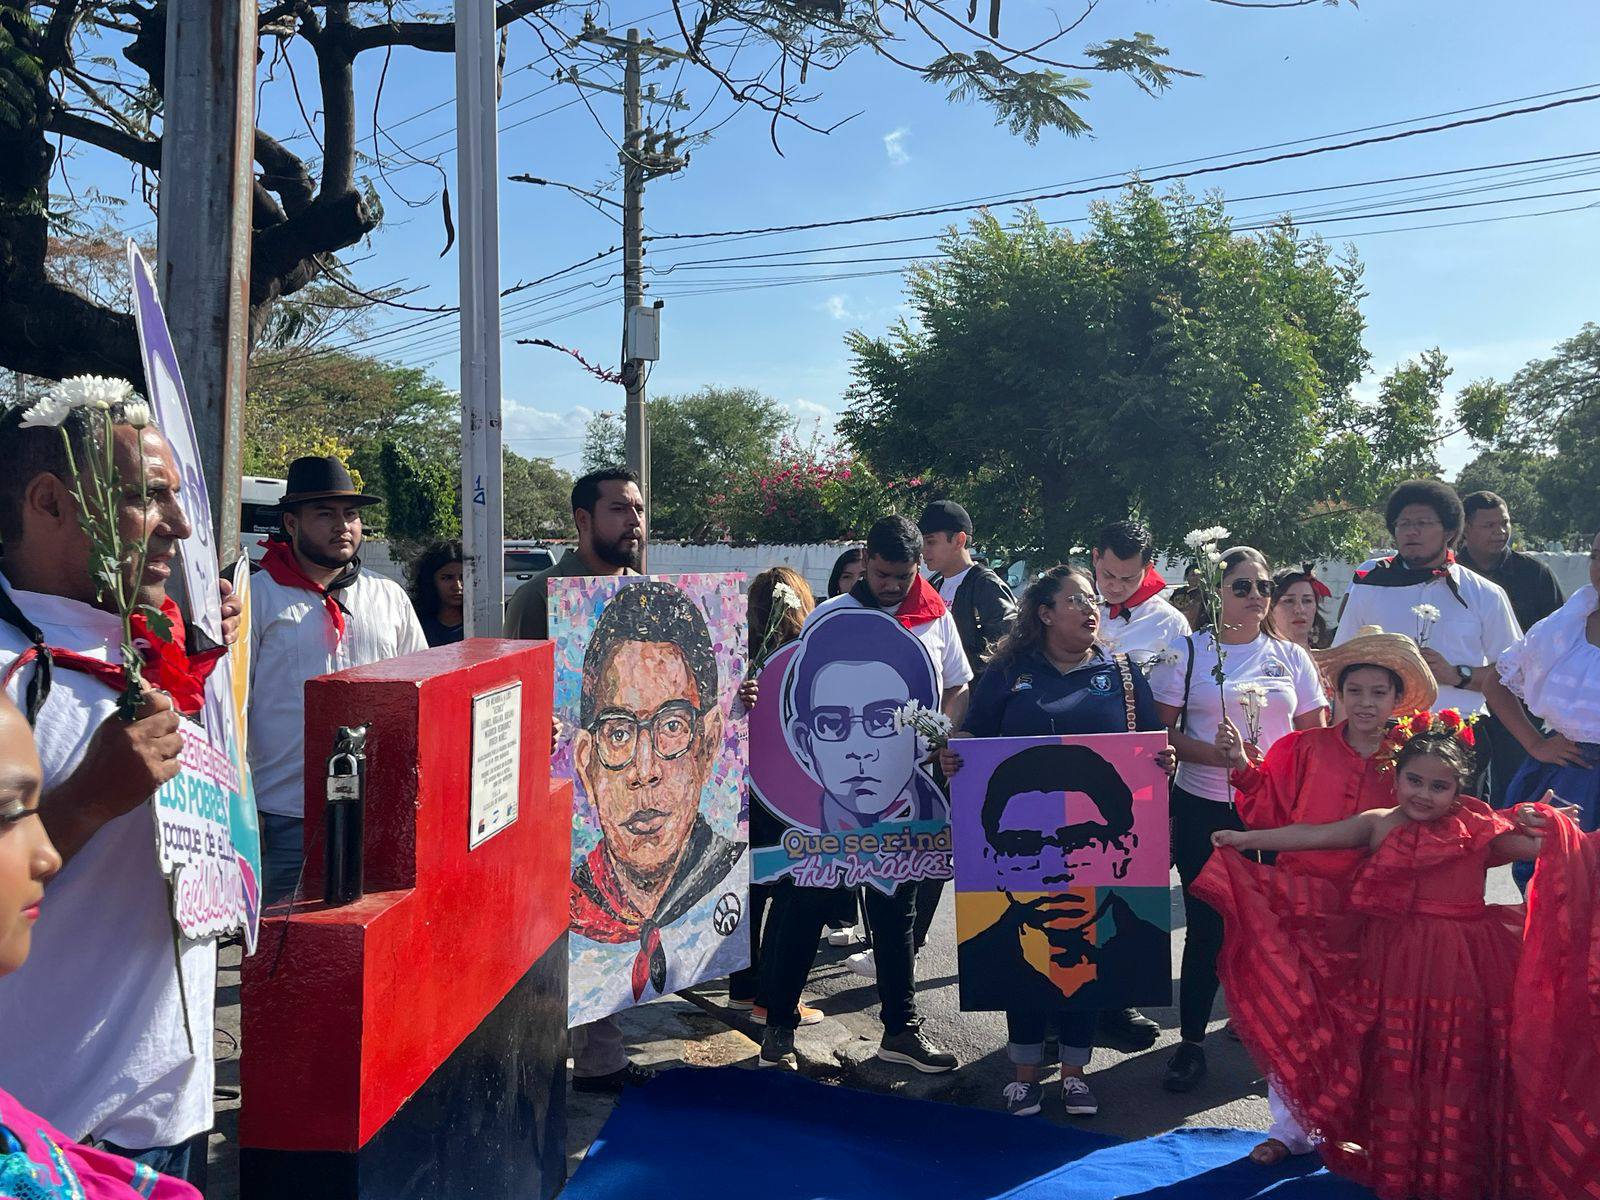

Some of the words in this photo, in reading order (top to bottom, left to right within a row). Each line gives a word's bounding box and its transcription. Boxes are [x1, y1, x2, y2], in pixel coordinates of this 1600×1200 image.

[1115, 652, 1135, 691] MARC
[1124, 695, 1137, 732] JACO
[162, 821, 202, 864] porque
[205, 822, 216, 857] de
[784, 830, 840, 860] Que
[845, 834, 879, 854] se
[881, 825, 951, 854] rind
